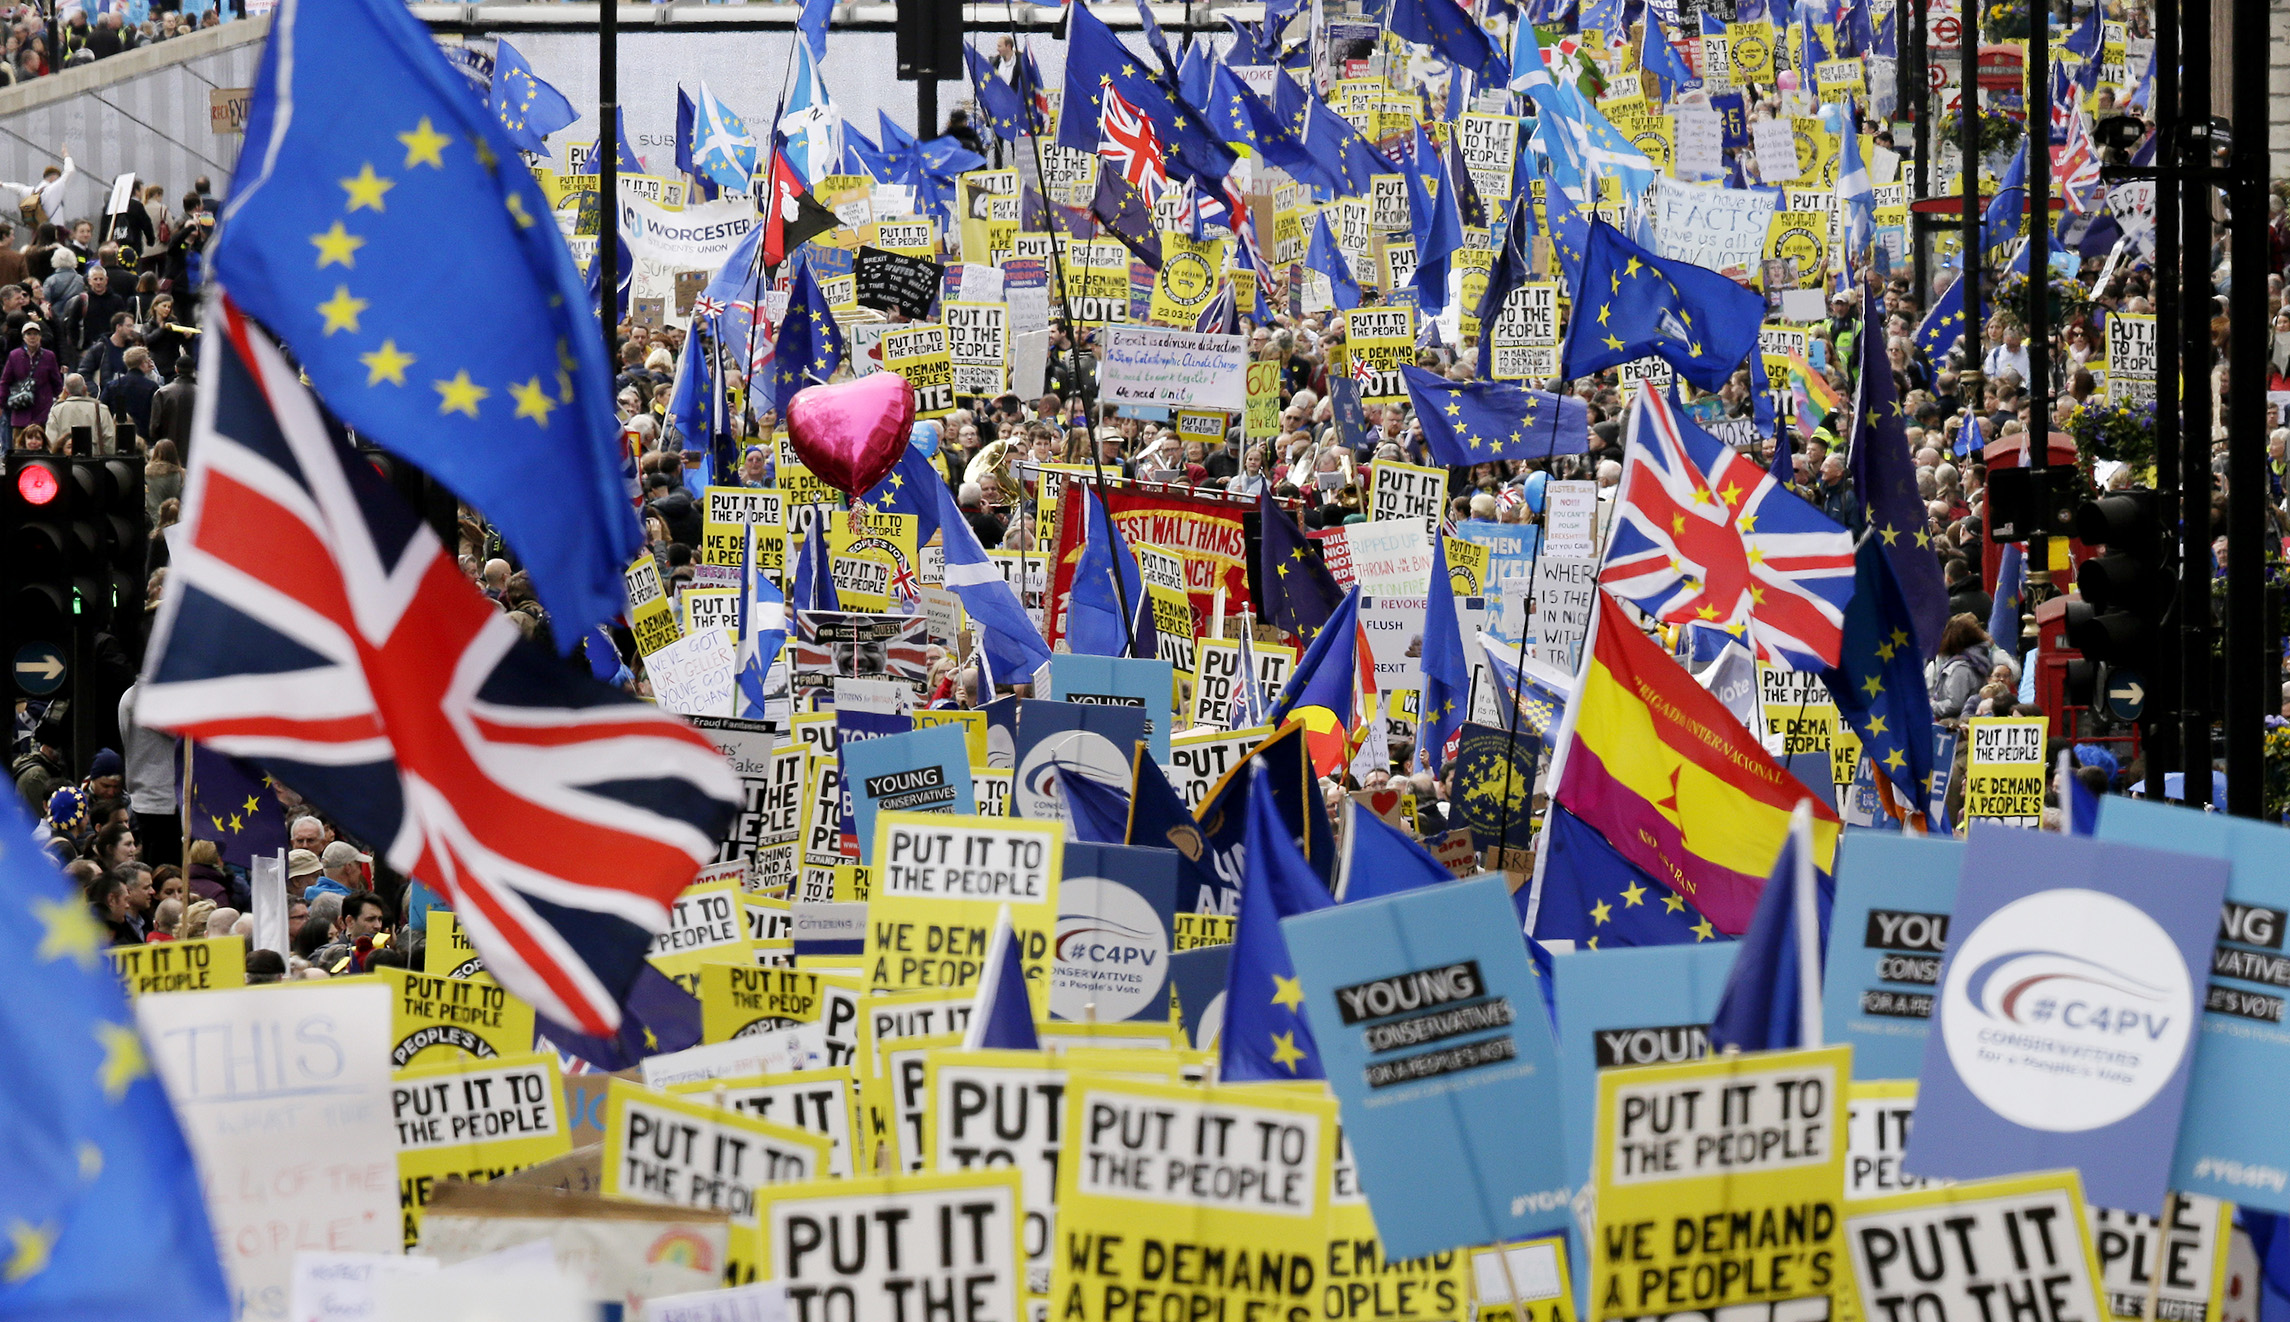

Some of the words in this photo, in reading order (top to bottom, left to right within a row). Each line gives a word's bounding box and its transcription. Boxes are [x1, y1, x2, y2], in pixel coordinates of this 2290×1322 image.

[1465, 120, 1492, 133] PUT
[1499, 123, 1511, 135] IT
[1465, 135, 1481, 148] TO
[1485, 137, 1509, 151] THE
[1463, 149, 1510, 163] PEOPLE
[1712, 194, 1746, 208] have
[1751, 198, 1774, 211] the
[1793, 195, 1824, 208] PUT
[1666, 202, 1763, 234] FACTS
[647, 219, 751, 241] WORCESTER
[880, 227, 899, 237] PUT
[903, 227, 911, 236] IT
[915, 227, 927, 236] TO
[1660, 228, 1693, 243] give
[1700, 233, 1717, 247] us
[1724, 233, 1748, 249] all
[649, 238, 695, 253] STUDENTS
[697, 244, 728, 253] UNION
[1017, 241, 1045, 255] PUT
[863, 255, 888, 263] BREXIT
[1004, 271, 1045, 280] STUDENTS
[948, 309, 982, 326] PUT
[987, 310, 1001, 326] IT
[1069, 298, 1127, 321] VOTE
[1500, 308, 1519, 323] TO
[1524, 308, 1551, 323] THE
[1352, 314, 1373, 326] PUT
[1377, 314, 1388, 326] IT
[1392, 313, 1405, 325] TO
[950, 329, 976, 341] TO
[981, 328, 1001, 341] THE
[1352, 327, 1370, 336] THE
[1373, 325, 1407, 335] PEOPLE
[888, 337, 909, 349] PUT
[913, 334, 924, 347] IT
[929, 332, 942, 344] TO
[889, 348, 906, 358] THE
[909, 342, 943, 355] PEOPLE
[1246, 362, 1279, 396] 60%
[1117, 386, 1130, 397] We
[1133, 387, 1154, 399] need
[1161, 387, 1193, 403] Unity
[1250, 419, 1262, 428] IN
[1266, 419, 1277, 428] EU
[1379, 469, 1415, 493] PUT
[1422, 476, 1440, 497] IT
[711, 495, 744, 509] PUT
[762, 497, 779, 511] TO
[1377, 492, 1397, 510] TO
[1405, 495, 1438, 517] THE
[707, 535, 726, 549] WE
[1352, 536, 1400, 553] RIPPED
[1404, 533, 1420, 548] UP
[834, 560, 857, 575] PUT
[859, 564, 870, 578] IT
[875, 567, 887, 580] TO
[1142, 550, 1157, 567] PUT
[1160, 556, 1170, 573] IT
[1170, 561, 1181, 577] TO
[1356, 559, 1394, 577] THROWN
[832, 575, 850, 588] THE
[851, 578, 885, 594] PEOPLE
[1385, 582, 1401, 595] ON
[1403, 578, 1427, 594] FIRE
[693, 598, 725, 614] PUT
[1381, 599, 1427, 609] REVOKE
[1542, 590, 1559, 604] IS
[1564, 590, 1589, 607] THE
[1367, 620, 1403, 630] FLUSH
[1543, 611, 1557, 623] IN
[859, 631, 873, 640] THE
[873, 624, 900, 636] QUEEN
[685, 648, 731, 677] GELLER
[801, 675, 823, 687] FROM
[1764, 688, 1788, 702] THE
[693, 717, 721, 728] Fraud
[1976, 728, 2001, 746] PUT
[2007, 728, 2019, 745] IT
[2023, 728, 2039, 745] TO
[1975, 747, 1992, 761] THE
[1996, 747, 2039, 761] PEOPLE
[870, 769, 937, 795] YOUNG
[1970, 778, 1989, 795] WE
[1992, 777, 2042, 794] DEMAND
[877, 785, 957, 811] CONSERVATIVES
[1969, 798, 1978, 813] A
[1981, 796, 2041, 814] PEOPLE'S
[891, 832, 948, 864] PUT
[964, 836, 994, 867] IT
[1007, 838, 1042, 869] TO
[1438, 838, 1467, 853] are
[764, 874, 790, 886] VOTE
[808, 870, 823, 882] I'M
[889, 866, 934, 891] THE
[944, 869, 1040, 897] PEOPLE
[875, 922, 915, 953] WE
[152, 949, 173, 973] IT
[184, 943, 211, 968] TO
[1070, 942, 1157, 968] #C4PV
[731, 968, 773, 992] PUT
[780, 972, 802, 993] IT
[873, 960, 888, 984] A
[405, 974, 446, 998] PUT
[453, 983, 472, 1003] IT
[482, 986, 505, 1011] TO
[1342, 965, 1474, 1019] YOUNG
[404, 998, 434, 1018] THE
[440, 1004, 503, 1028] PEOPLE
[2031, 996, 2171, 1041] #C4PV
[164, 1012, 347, 1096] THIS
[392, 1083, 450, 1118] PUT
[463, 1078, 492, 1110] IT
[505, 1074, 544, 1104] TO
[1622, 1091, 1702, 1138] PUT
[1721, 1086, 1756, 1126] IT
[1776, 1079, 1822, 1121] TO
[396, 1118, 446, 1144] THE
[453, 1106, 549, 1140] PEOPLE
[1089, 1105, 1176, 1151] PUT
[1199, 1113, 1236, 1159] IT
[1255, 1121, 1307, 1166] TO
[629, 1111, 698, 1167] PUT
[715, 1134, 746, 1179] IT
[1621, 1141, 1680, 1175] THE
[1697, 1124, 1822, 1168] PEOPLE
[626, 1157, 673, 1200] THE
[1088, 1152, 1154, 1190] THE
[1166, 1160, 1303, 1206] PEOPLE
[786, 1208, 909, 1279] PUT
[939, 1202, 995, 1268] IT
[1603, 1222, 1655, 1263] WE
[1674, 1202, 1835, 1257] DEMAND
[1860, 1217, 1976, 1289] PUT
[2004, 1206, 2056, 1271] IT
[1068, 1233, 1123, 1276] WE
[1142, 1239, 1315, 1296] DEMAND
[1603, 1274, 1623, 1310] A
[1638, 1251, 1832, 1307] PEOPLE'S
